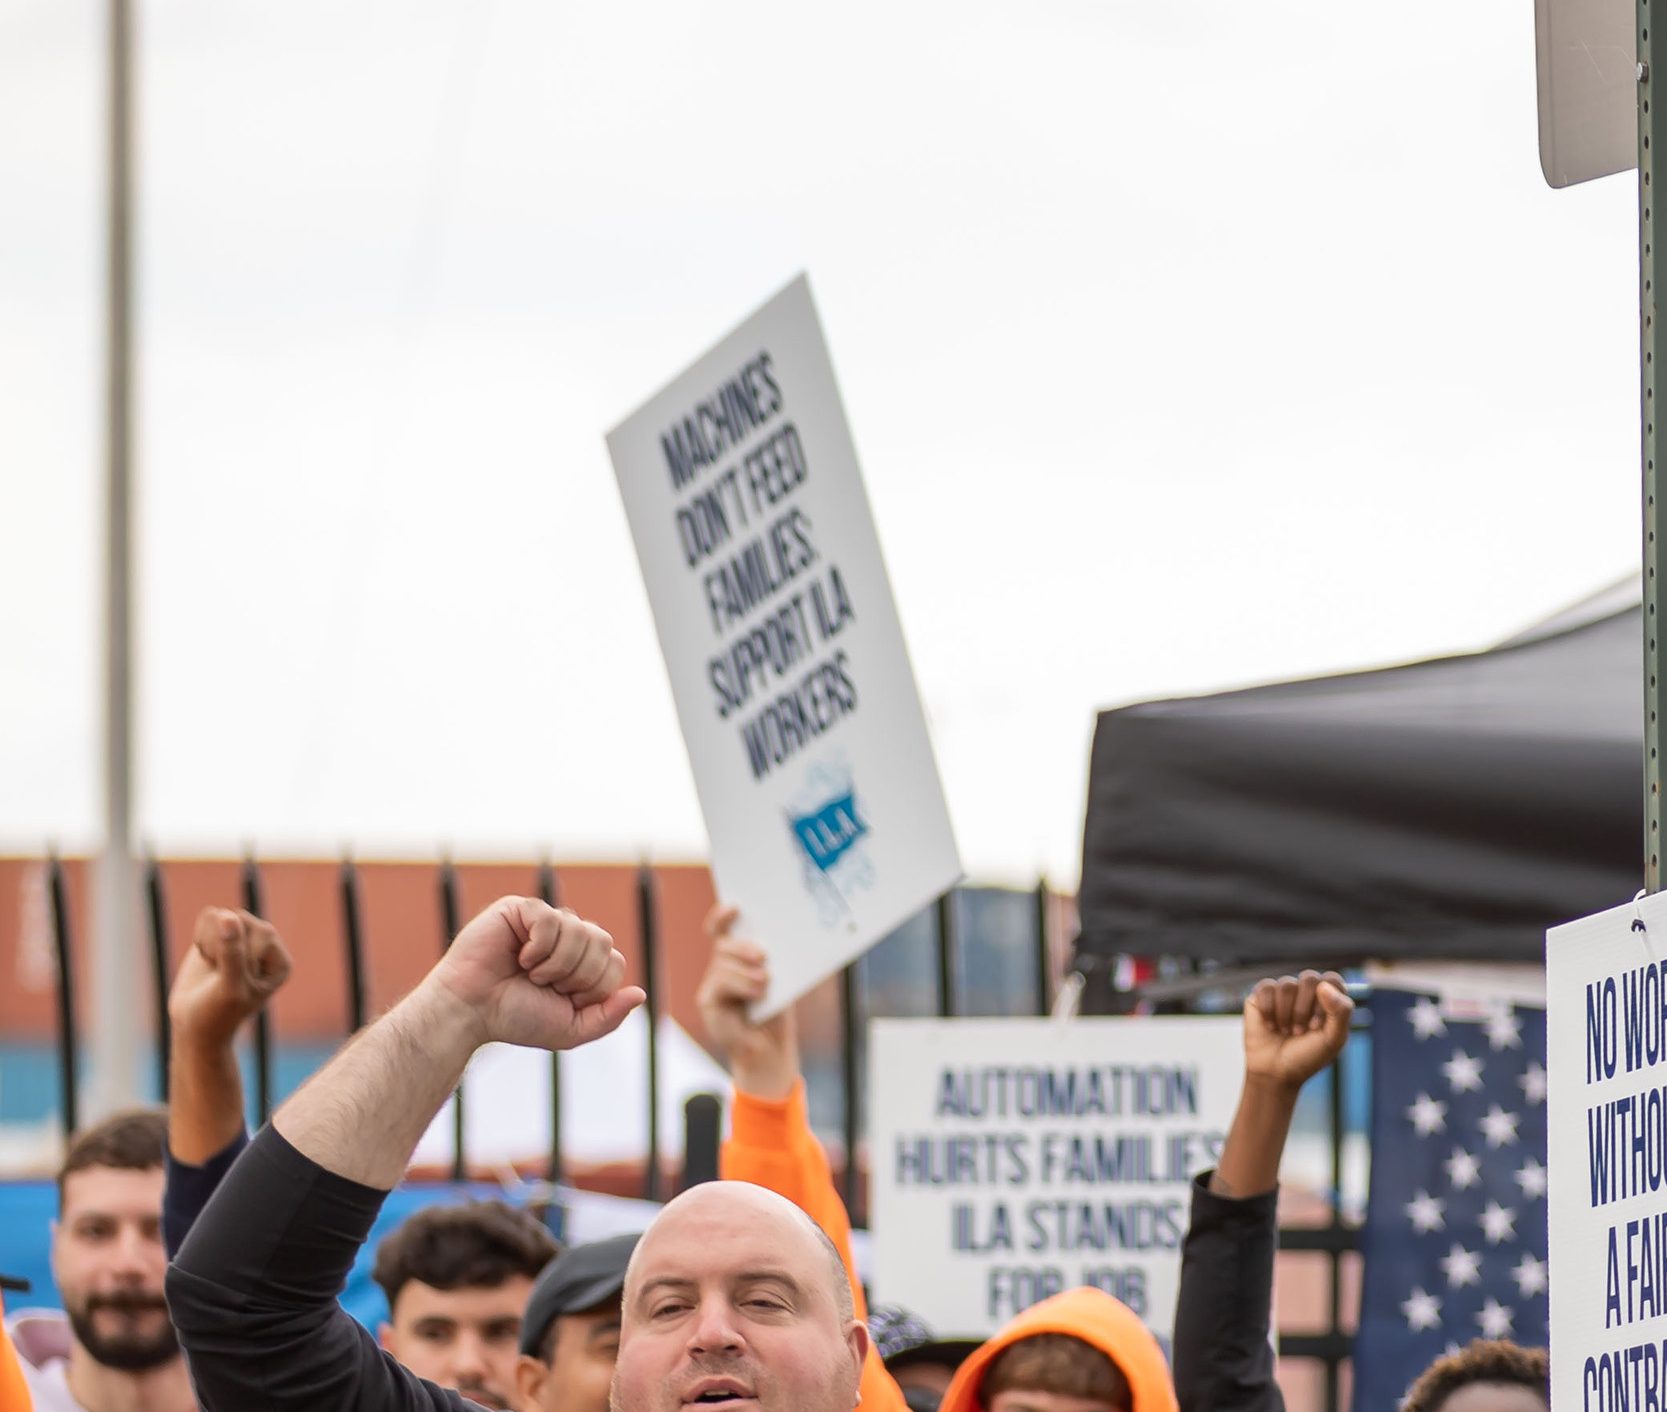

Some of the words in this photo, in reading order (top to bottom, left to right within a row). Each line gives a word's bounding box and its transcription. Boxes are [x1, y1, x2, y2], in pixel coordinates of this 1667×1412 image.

[661, 350, 783, 491] MACHINES
[677, 468, 748, 568] DON'T
[744, 421, 808, 514] FEED
[708, 593, 813, 719] SUPPORT
[810, 565, 855, 641] ILA
[741, 649, 857, 781] WORKERS
[1586, 975, 1617, 1084] NO
[935, 1065, 1199, 1118] AUTOMATION
[896, 1133, 1028, 1186] HURTS
[952, 1203, 1012, 1252] ILA
[1025, 1202, 1184, 1252] STANDS
[1605, 1225, 1622, 1329] A
